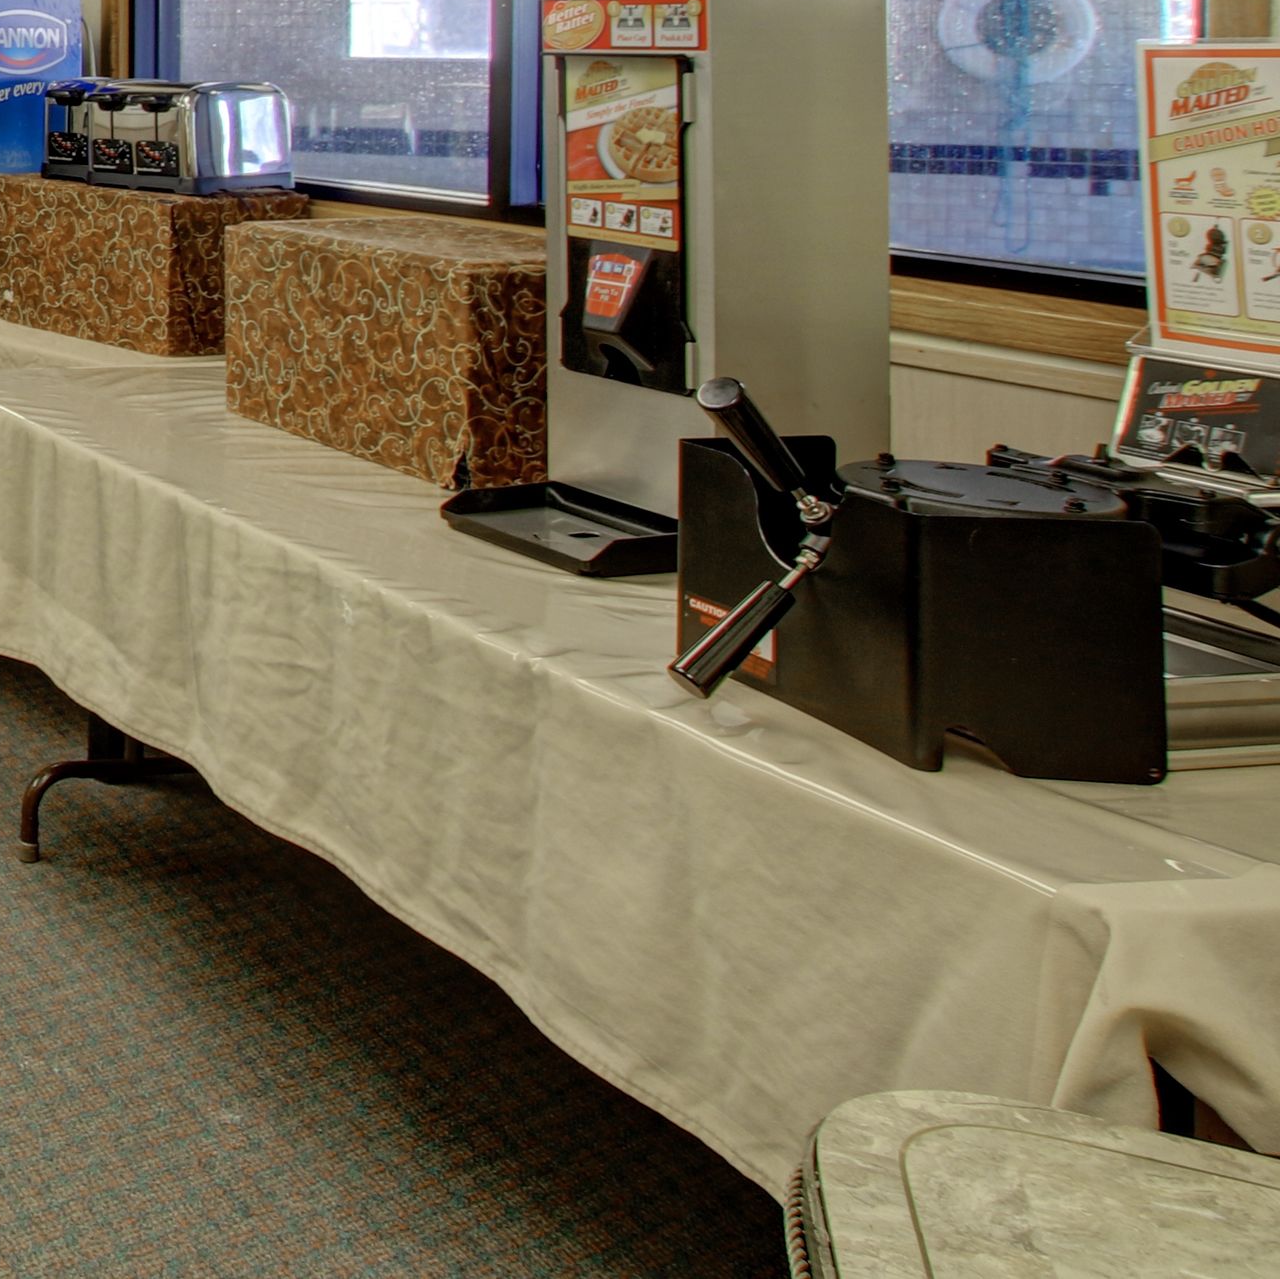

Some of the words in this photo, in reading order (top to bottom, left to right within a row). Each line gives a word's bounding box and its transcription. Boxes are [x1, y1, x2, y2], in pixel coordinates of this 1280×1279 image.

[547, 3, 589, 26] Better
[555, 12, 596, 34] Batter
[13, 81, 45, 98] every
[576, 79, 619, 101] MALTED
[1176, 67, 1257, 98] GOLDEN
[1169, 85, 1250, 117] MALTED
[1173, 126, 1248, 152] CAUTION
[1252, 117, 1280, 136] HO
[1255, 229, 1264, 240] 2
[1181, 378, 1263, 396] GOLDEN
[1160, 392, 1237, 408] MALTED
